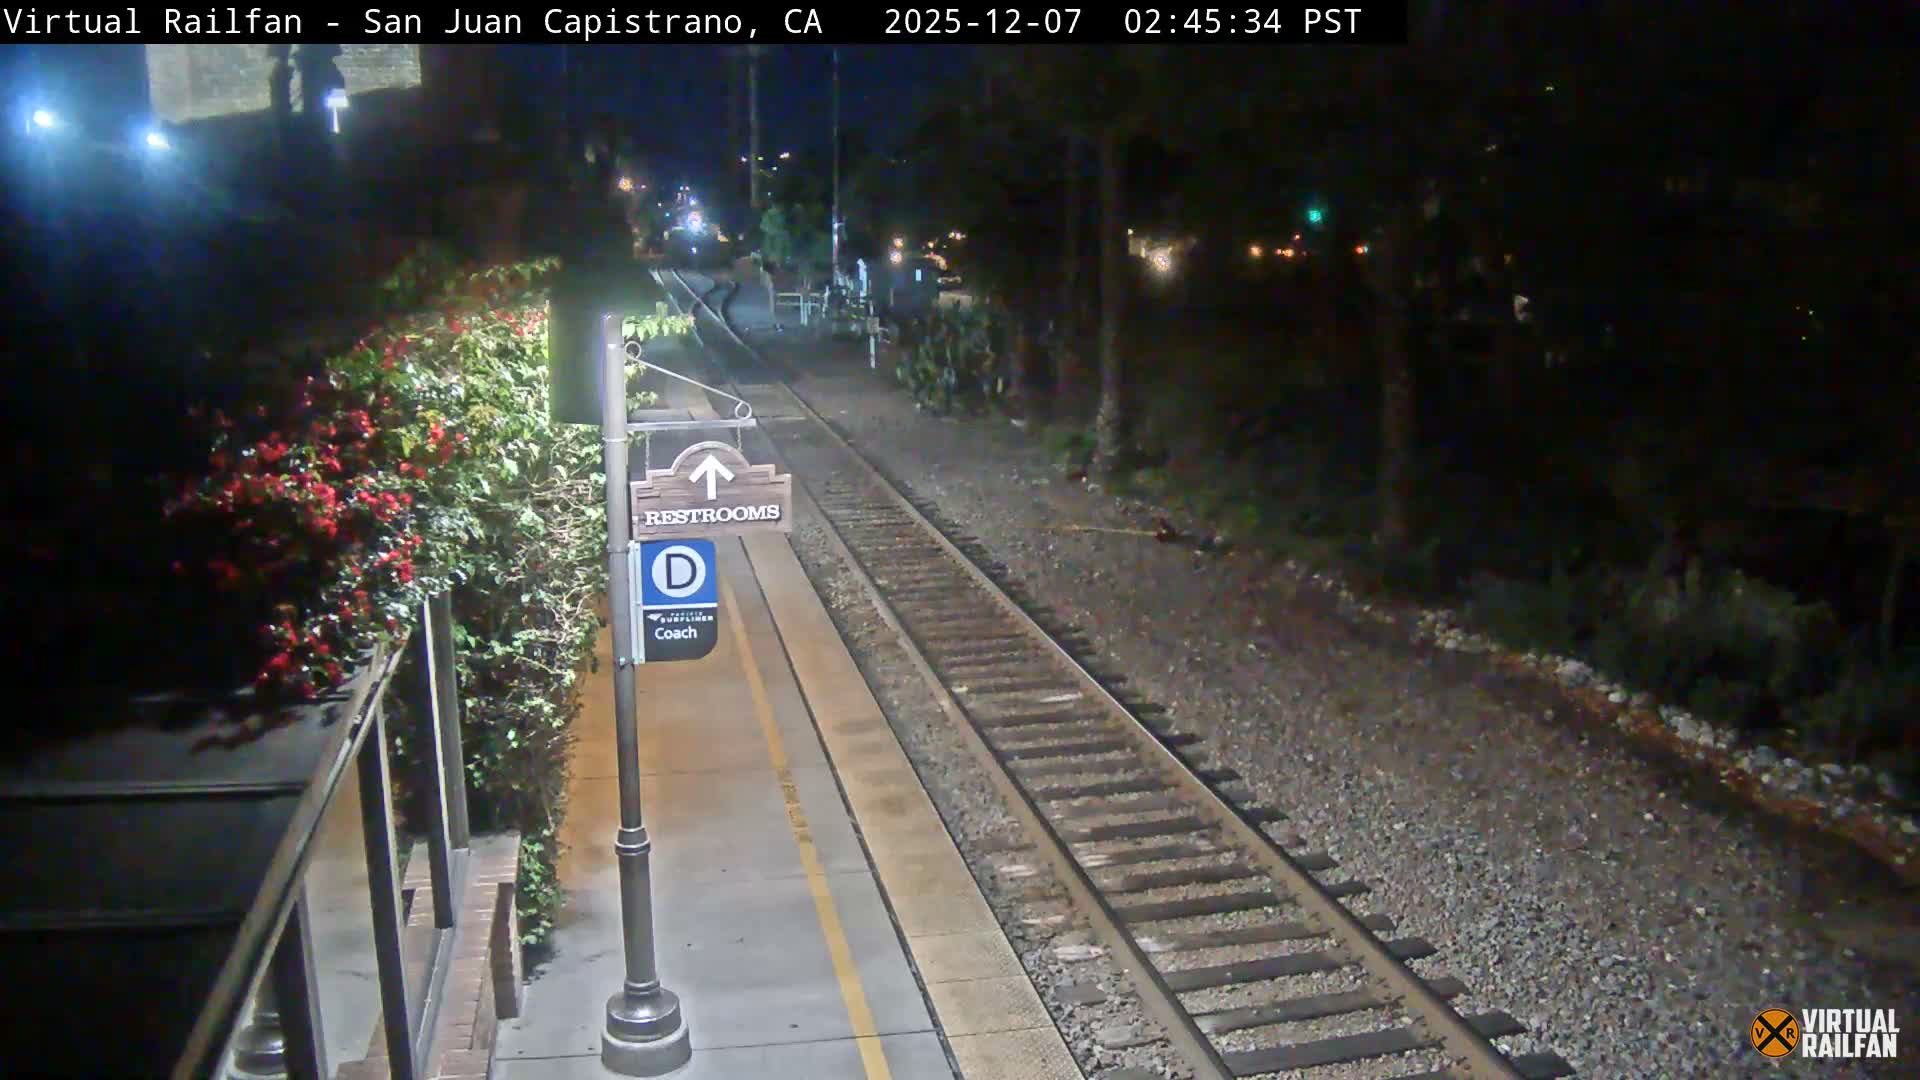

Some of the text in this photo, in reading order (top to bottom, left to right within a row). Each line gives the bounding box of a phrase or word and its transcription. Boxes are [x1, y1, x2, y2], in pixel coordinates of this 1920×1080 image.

[644, 504, 781, 526] RESTROOMS
[665, 553, 697, 590] D
[654, 625, 698, 640] Coach
